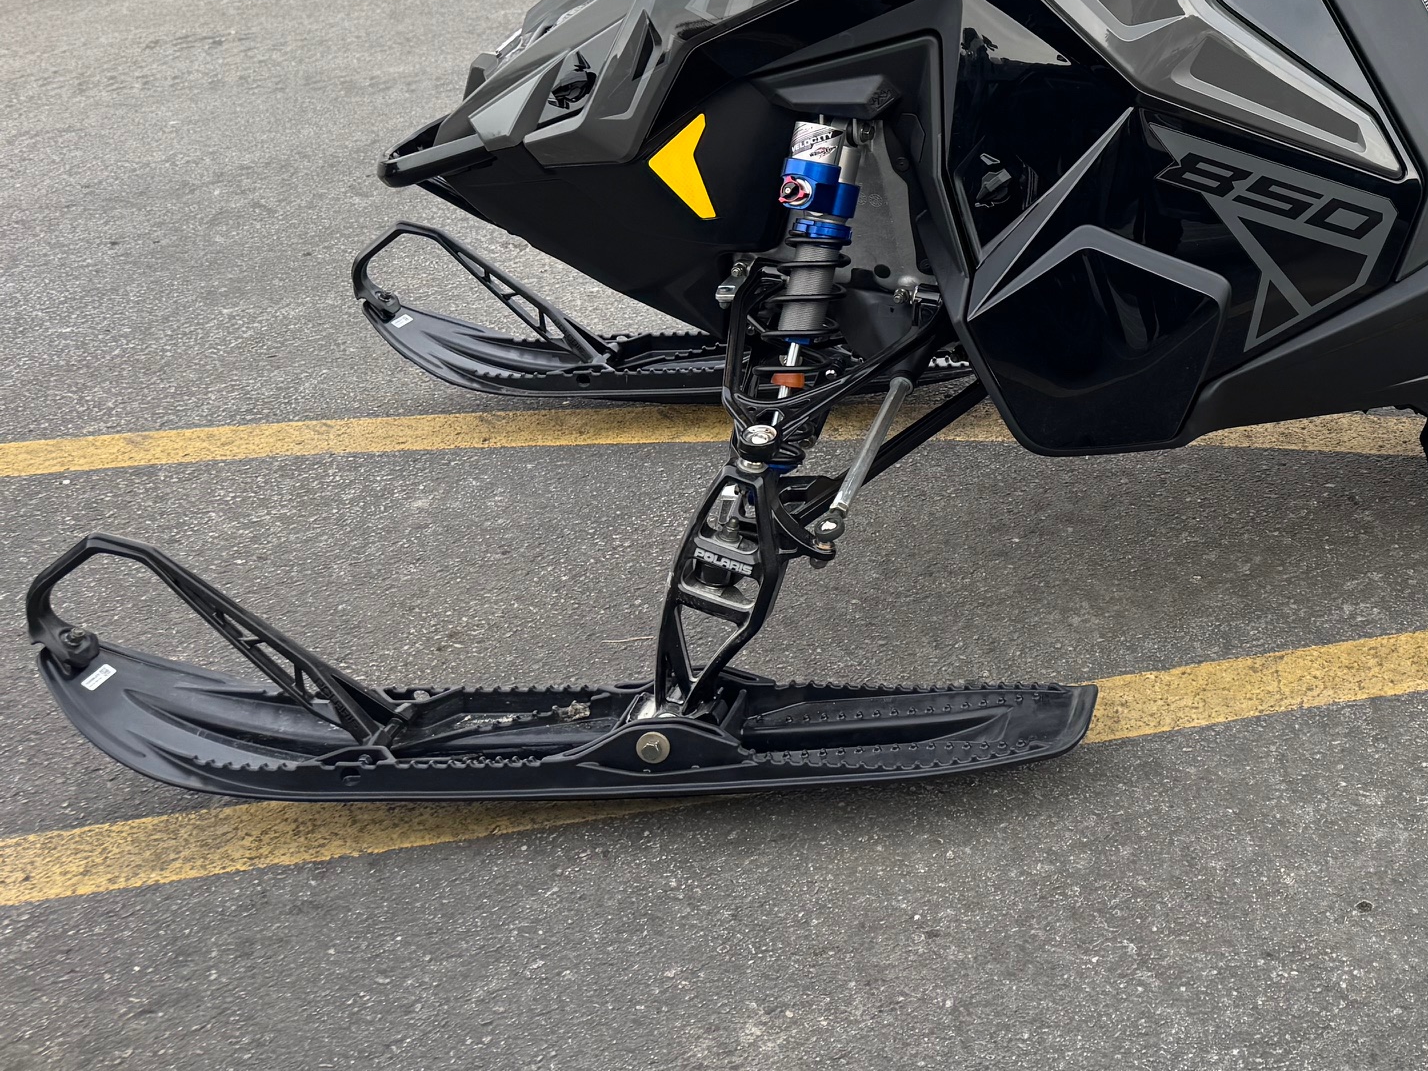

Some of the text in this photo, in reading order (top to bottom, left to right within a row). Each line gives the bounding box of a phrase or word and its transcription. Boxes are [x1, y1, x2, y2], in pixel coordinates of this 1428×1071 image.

[791, 131, 834, 153] VELOCITY
[1157, 152, 1384, 240] 850
[694, 547, 753, 575] POLARIS
